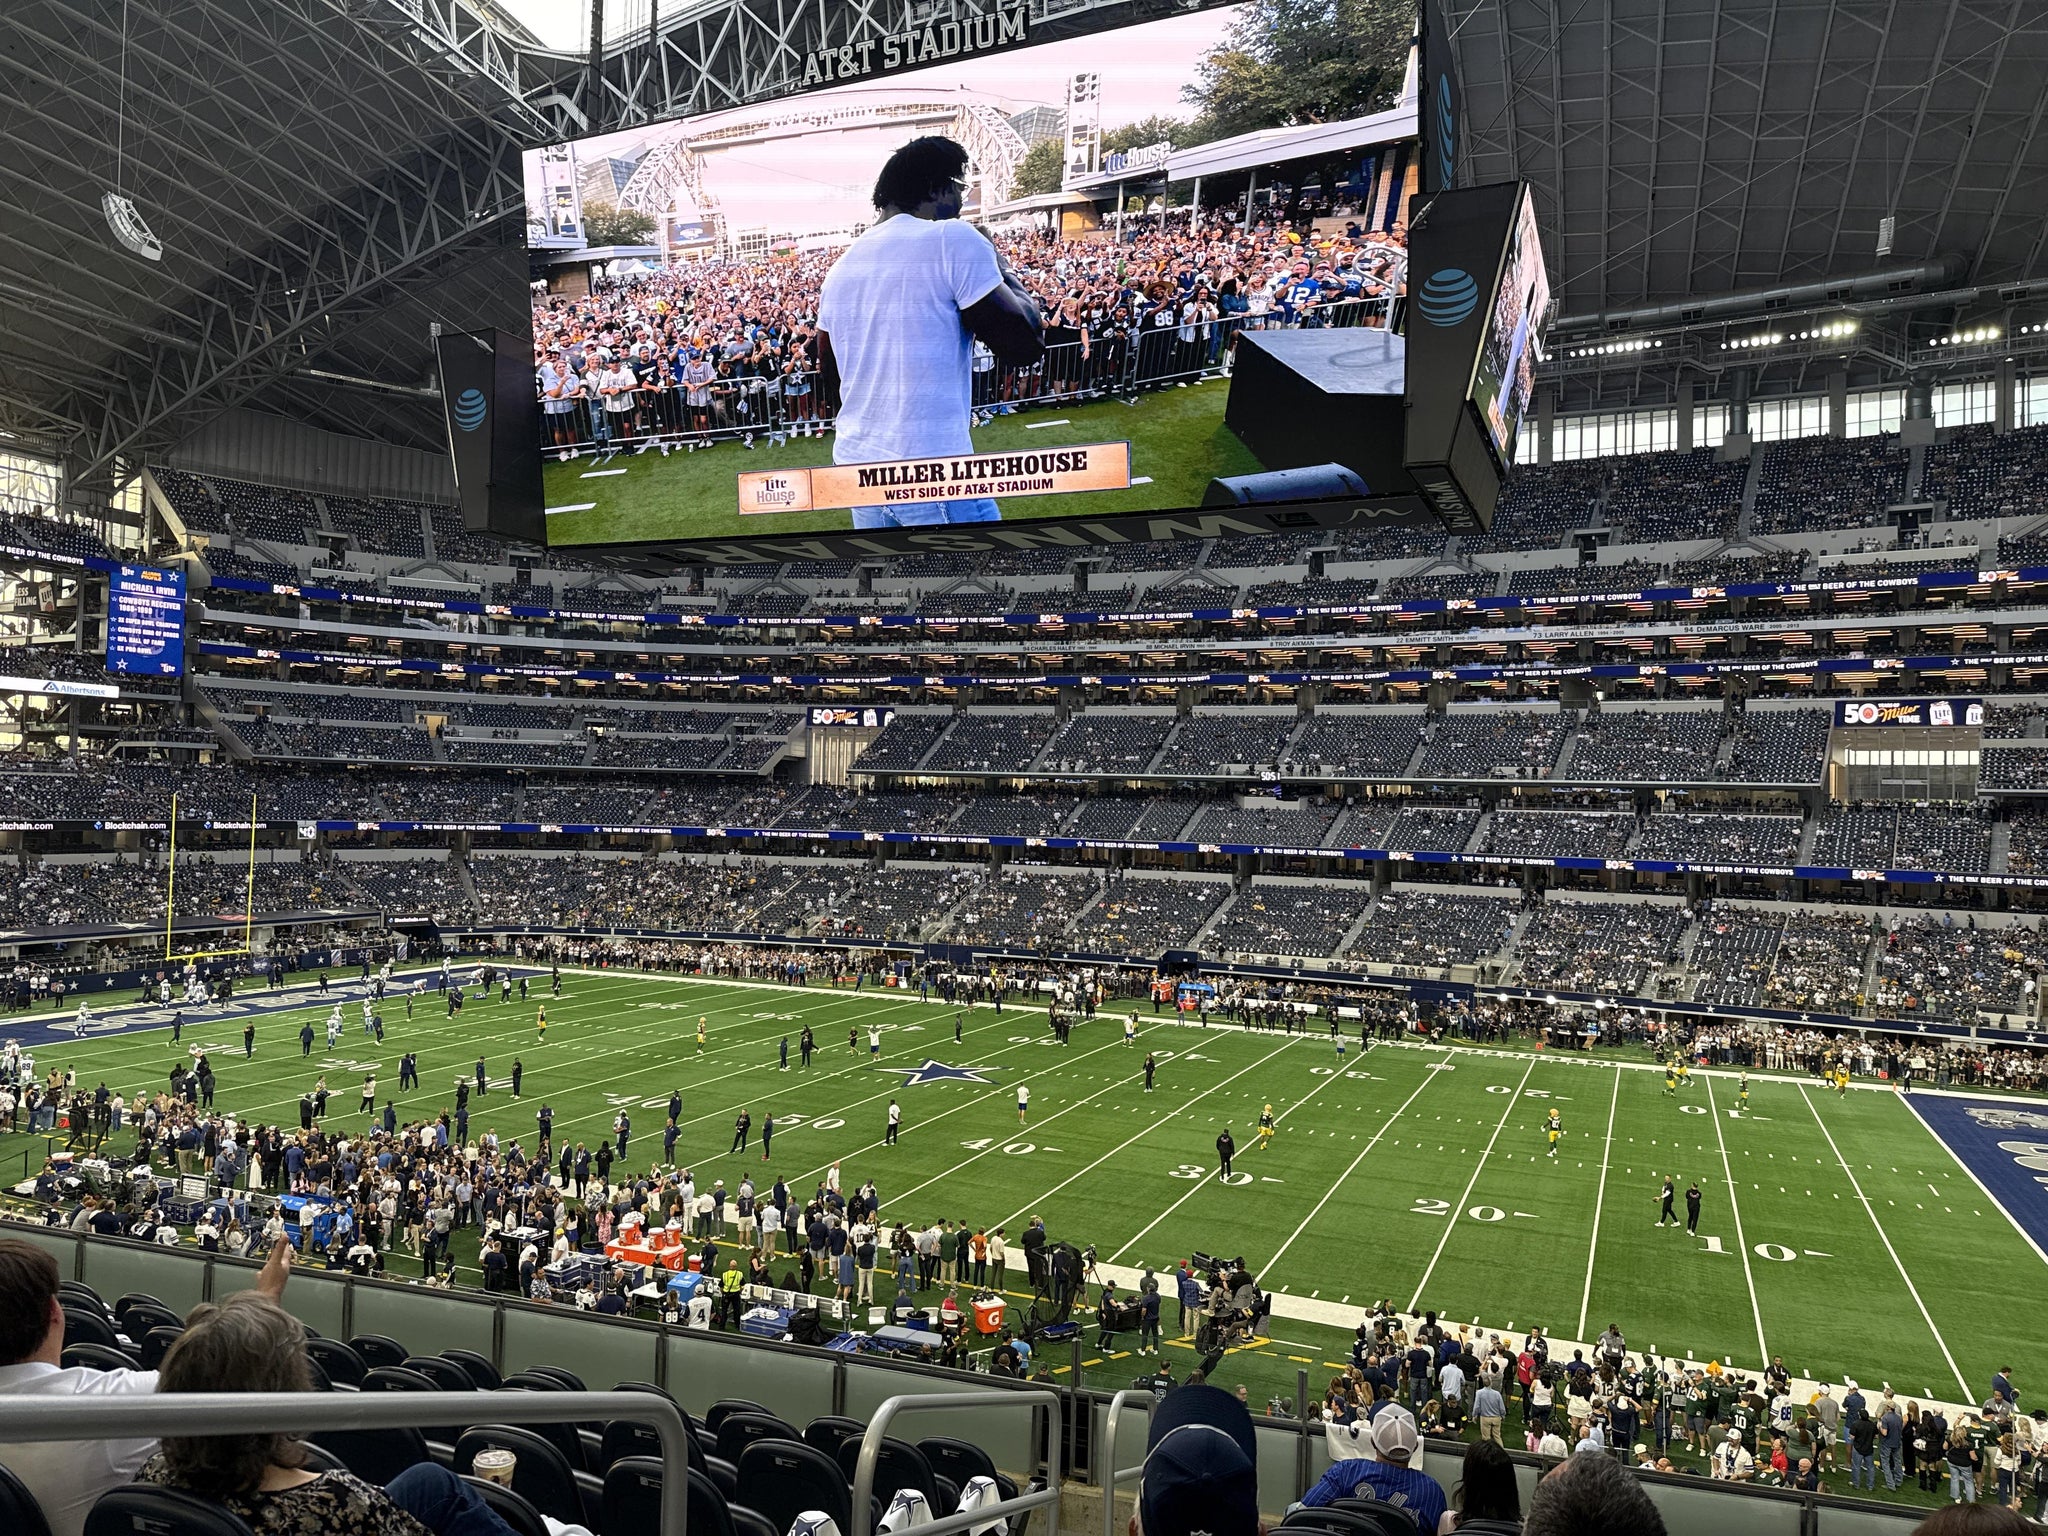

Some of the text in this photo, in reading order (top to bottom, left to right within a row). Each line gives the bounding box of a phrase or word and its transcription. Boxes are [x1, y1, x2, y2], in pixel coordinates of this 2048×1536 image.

[802, 6, 1026, 86] AT&T STADIUM
[1127, 141, 1171, 168] House
[1284, 287, 1311, 304] 12
[1155, 311, 1174, 327] 88
[858, 450, 1088, 487] MILLER LITEHOUSE
[764, 478, 787, 492] Lite
[884, 478, 1053, 501] WEST SIDE OF AT&T STADIUM
[756, 489, 796, 504] House
[1424, 480, 1474, 529] WINSTAR
[6, 546, 26, 556] BEER
[38, 552, 50, 560] THE
[52, 554, 84, 565] COWBOYS
[121, 581, 176, 596] MICHAEL IRVIN
[1790, 583, 1806, 592] THE
[1822, 581, 1844, 590] BEER
[1859, 580, 1876, 588] THE
[1877, 577, 1918, 587] COWBOYS
[14, 596, 37, 607] FILLING
[118, 596, 180, 610] COWBOYS RECEIVER
[1560, 595, 1578, 603] BEER
[1591, 594, 1605, 602] THE
[1606, 592, 1642, 601] COWBOYS
[1307, 607, 1319, 615] THE
[1330, 606, 1347, 614] BEER
[1358, 605, 1371, 613] THE
[1372, 604, 1403, 612] COWBOYS
[60, 684, 106, 696] Albertsons
[812, 708, 834, 725] 50
[1844, 702, 1878, 724] 50
[1880, 705, 1921, 722] Miller
[104, 822, 166, 831] Blockchain.com
[299, 826, 316, 838] 40
[1734, 866, 1743, 874] OF
[1760, 867, 1794, 876] COWBOYS
[1980, 876, 2001, 884] BEER
[2003, 877, 2016, 885] OF
[2017, 878, 2032, 887] THE
[772, 1113, 845, 1130] 50
[960, 1138, 1037, 1155] 40
[1168, 1164, 1255, 1187] 30
[1409, 1198, 1506, 1222] 20
[1697, 1235, 1797, 1262] 10
[665, 1312, 678, 1323] 88
[697, 1308, 705, 1320] 4
[987, 1311, 1000, 1326] G
[1601, 1382, 1614, 1396] 12
[1781, 1406, 1792, 1420] 88
[1735, 1415, 1747, 1429] 10
